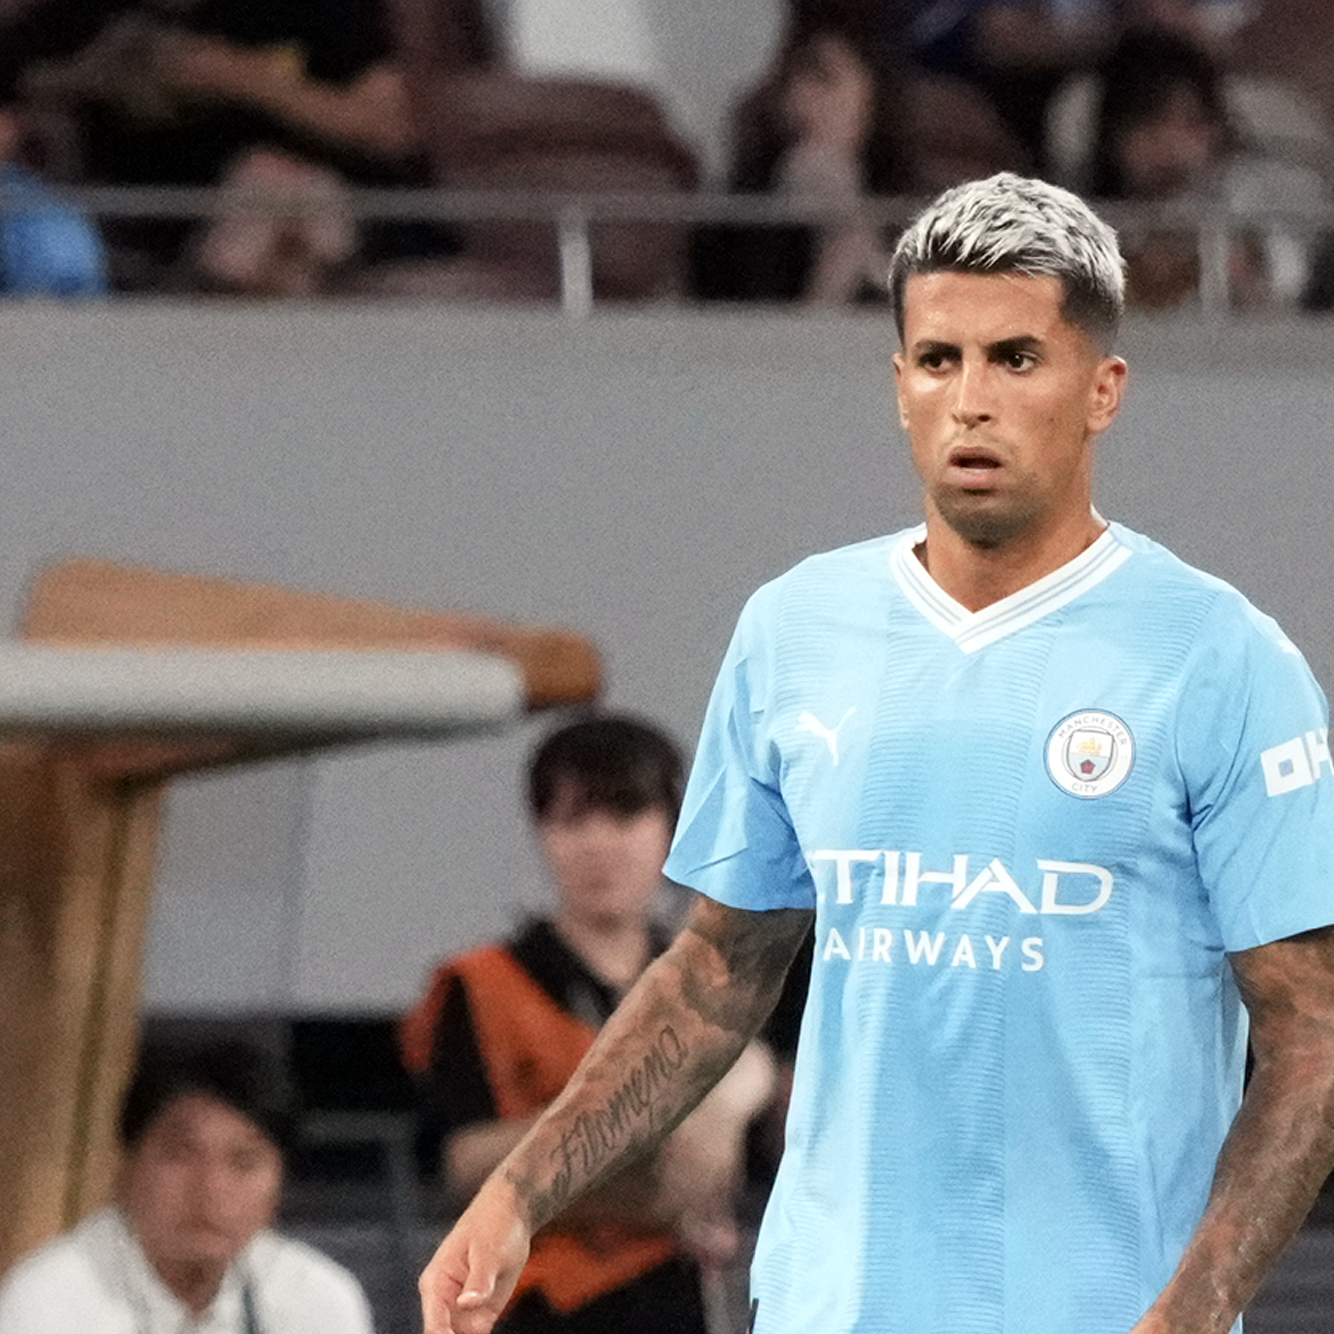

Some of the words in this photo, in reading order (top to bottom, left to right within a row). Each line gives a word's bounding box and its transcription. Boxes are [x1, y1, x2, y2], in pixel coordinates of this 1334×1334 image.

[1058, 716, 1127, 746] MANCHESTER
[1071, 782, 1098, 793] CITY
[808, 850, 1114, 915] TIHAD
[823, 927, 1045, 972] AIRWAYS
